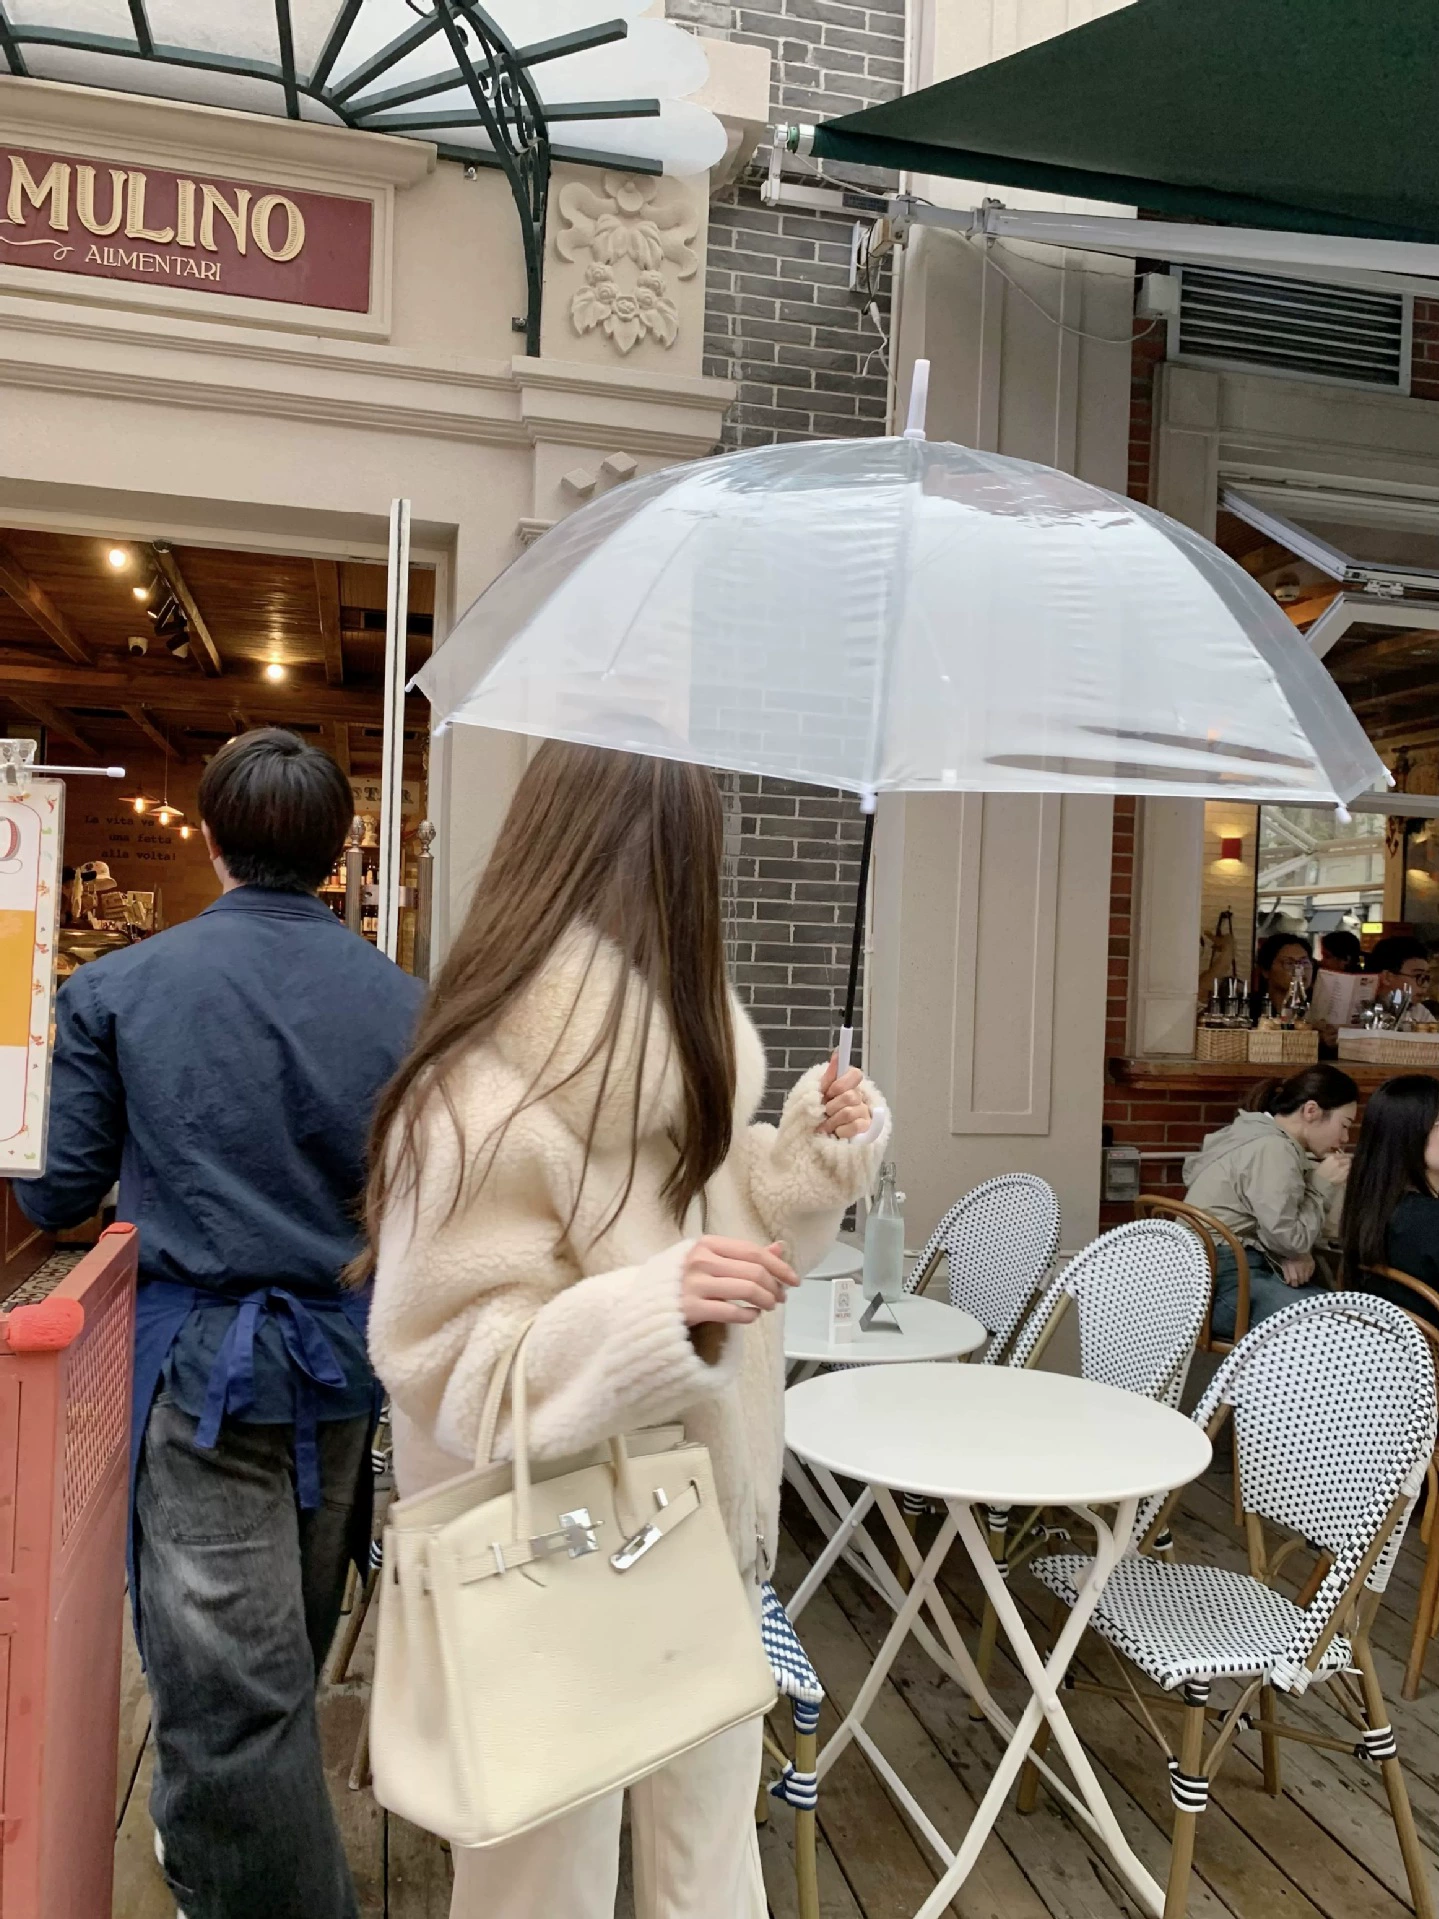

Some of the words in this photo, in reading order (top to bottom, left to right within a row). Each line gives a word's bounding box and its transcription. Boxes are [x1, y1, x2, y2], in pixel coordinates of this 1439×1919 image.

[7, 155, 306, 262] MULINO
[85, 244, 222, 281] ALIMENTARI
[106, 815, 134, 825] vita
